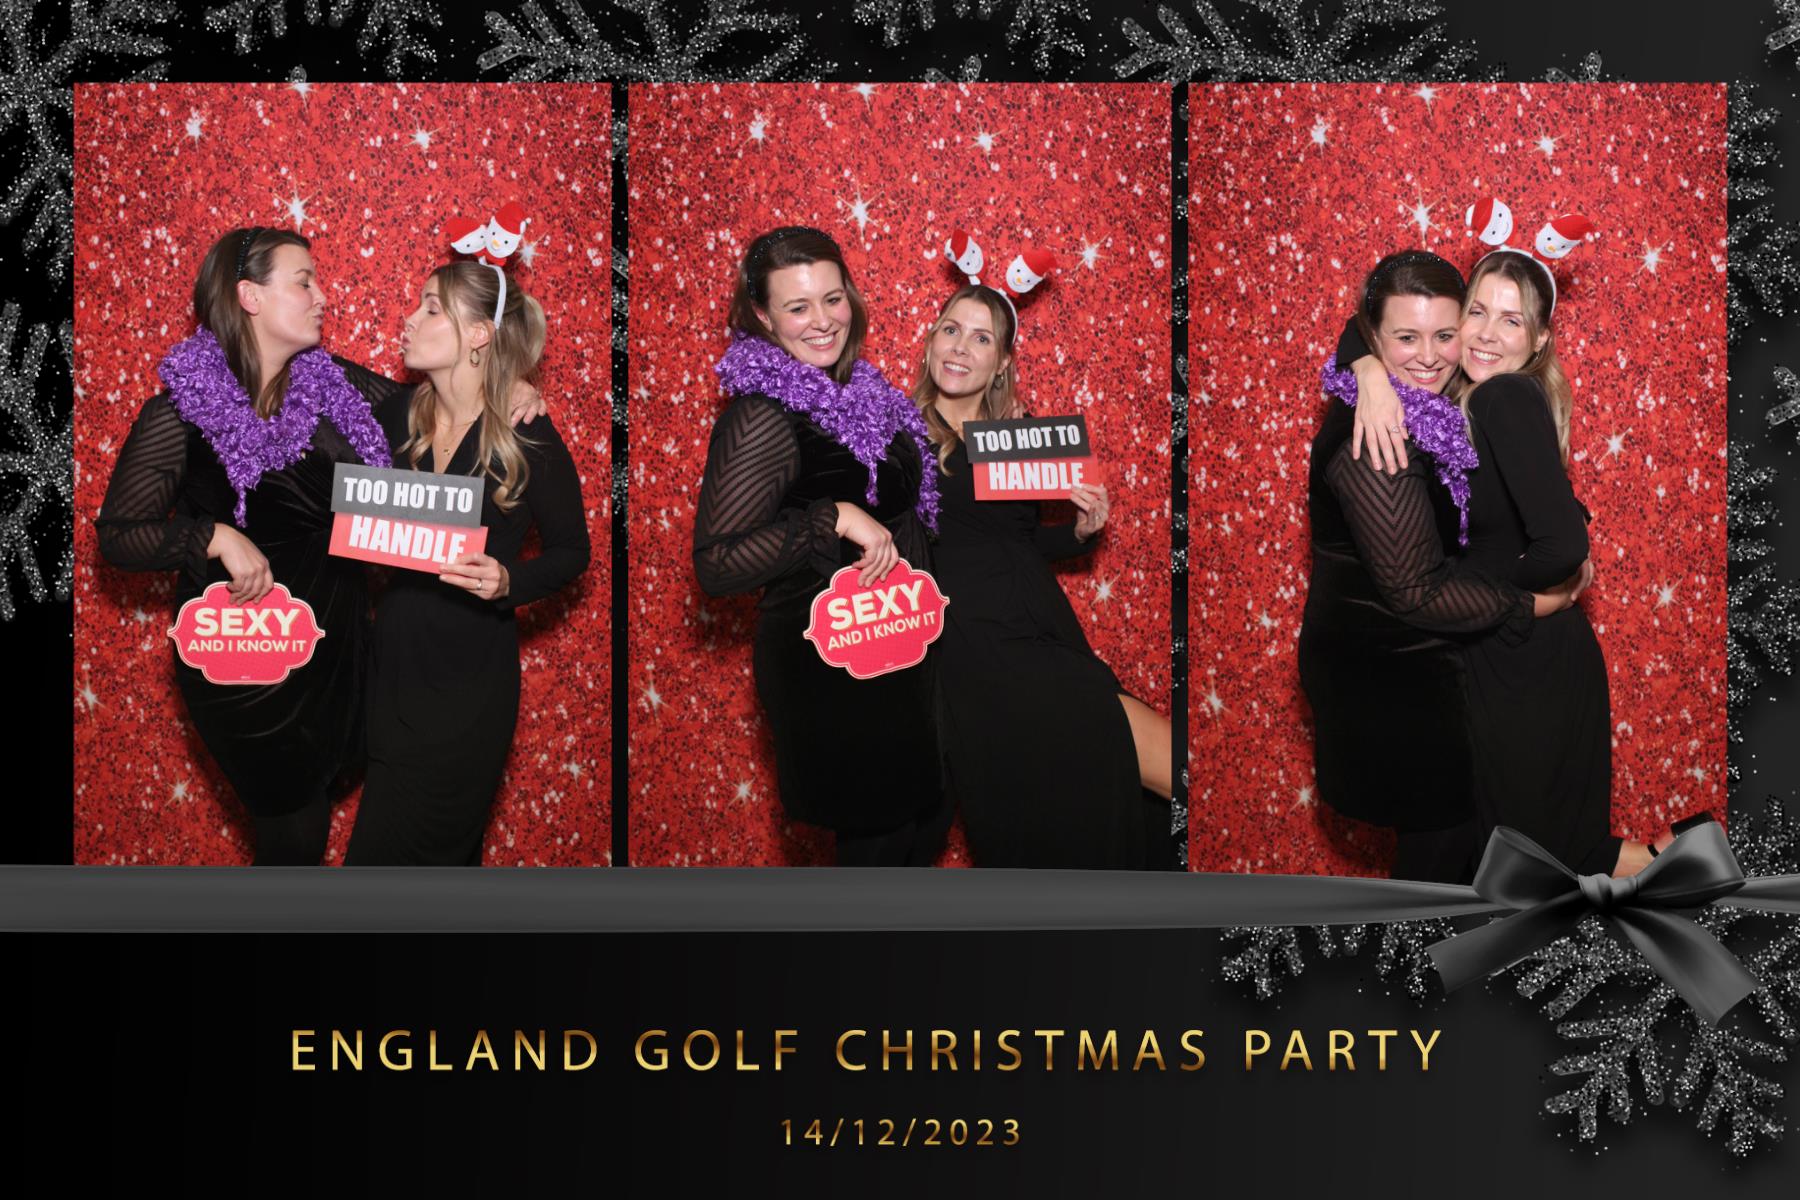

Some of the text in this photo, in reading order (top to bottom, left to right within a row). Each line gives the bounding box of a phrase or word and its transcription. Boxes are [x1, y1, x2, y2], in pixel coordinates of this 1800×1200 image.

[973, 424, 1081, 453] TOO HOT TO
[988, 462, 1084, 491] HANDLE
[343, 477, 474, 513] TOO HOT TO
[348, 514, 467, 565] HANDLE
[826, 579, 924, 631] SEXY
[194, 607, 300, 637] SEXY
[827, 611, 936, 651] AND I KNOW IT
[187, 639, 307, 653] AND I KNOW IT
